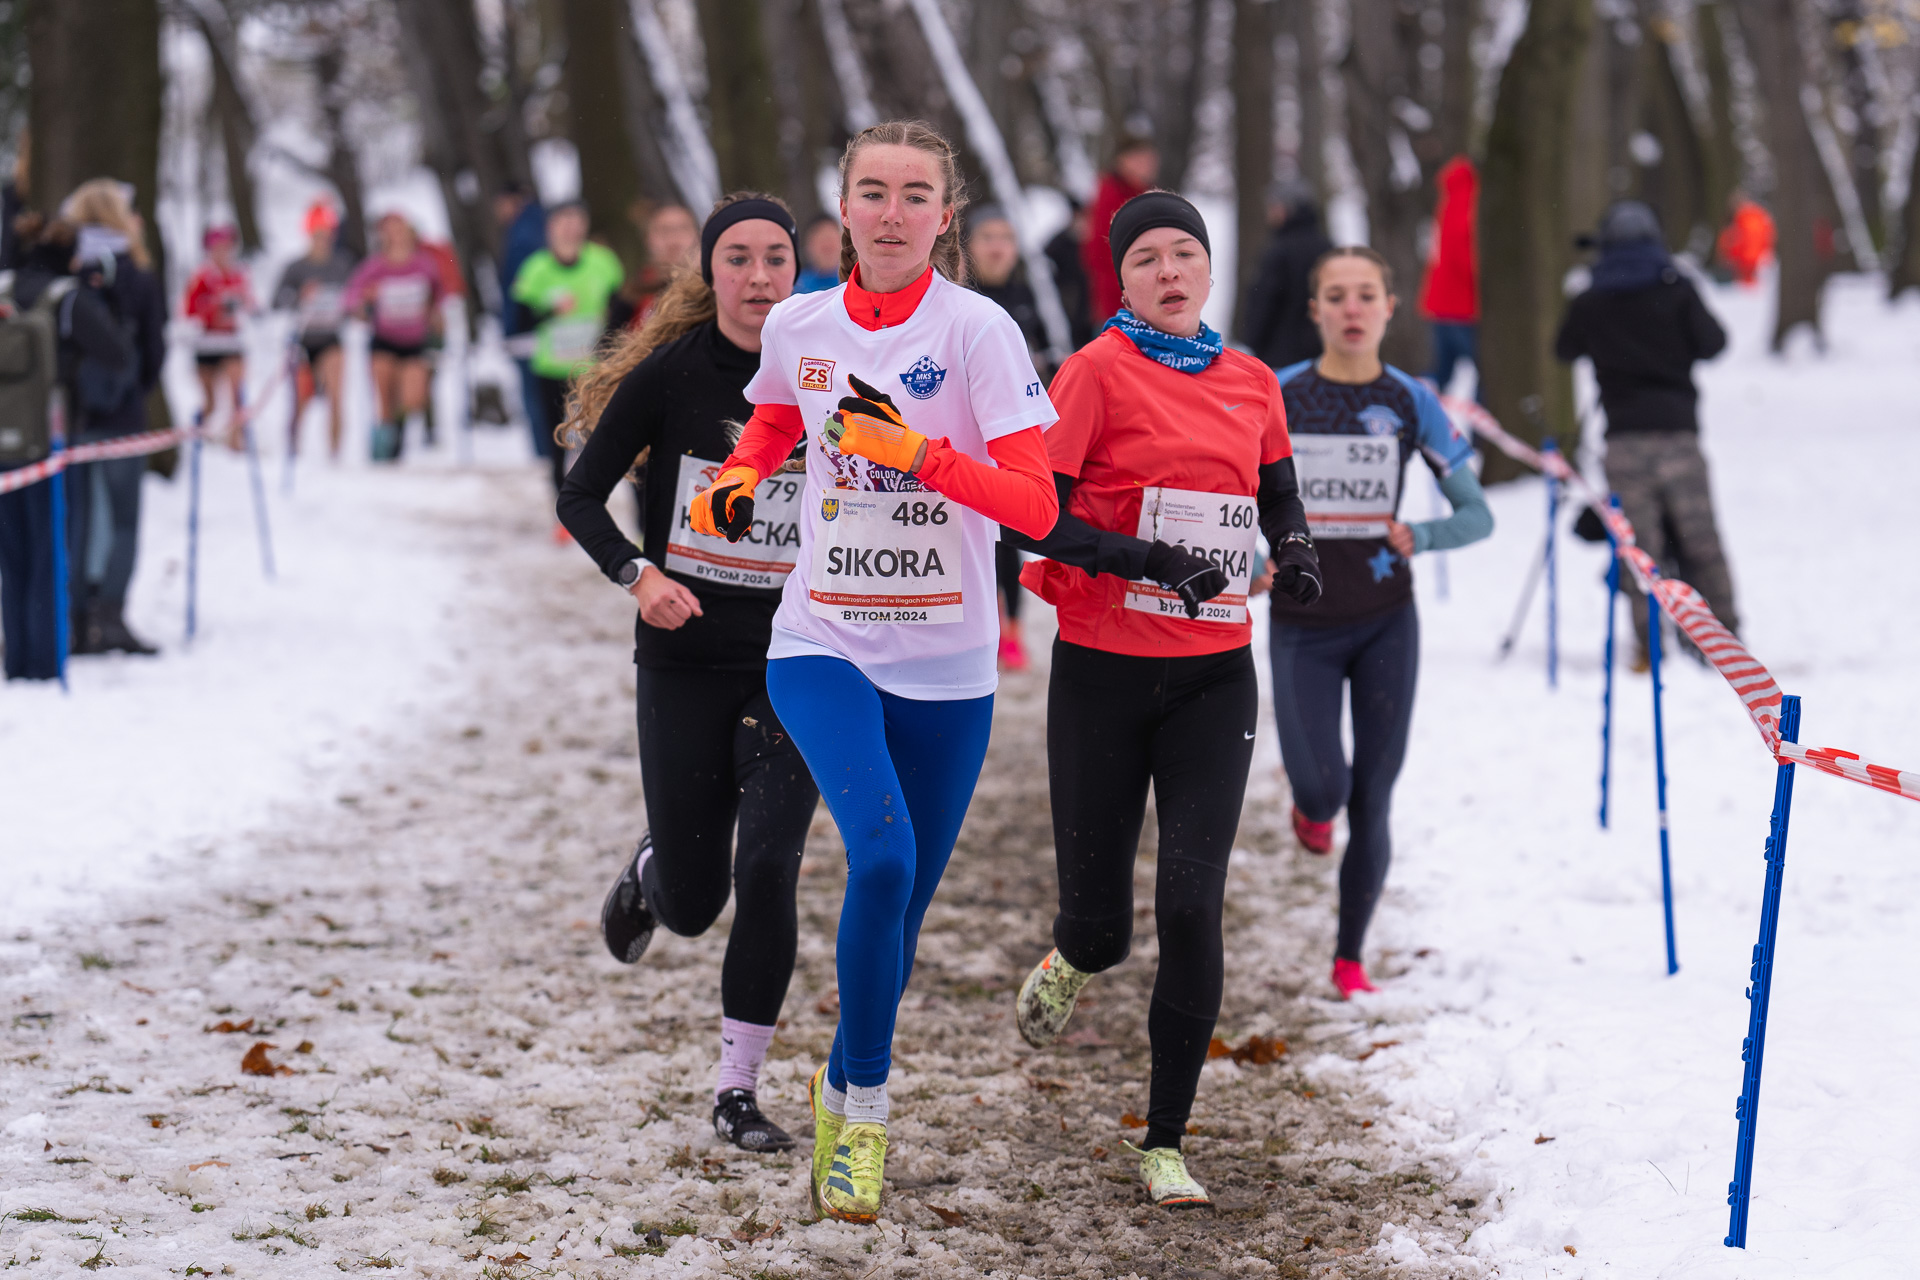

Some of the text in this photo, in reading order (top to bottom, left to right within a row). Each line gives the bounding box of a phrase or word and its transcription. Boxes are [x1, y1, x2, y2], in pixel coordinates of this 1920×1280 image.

[803, 367, 827, 383] ZS
[1026, 382, 1040, 397] 47
[1347, 443, 1389, 463] 529
[869, 470, 896, 479] COLOR
[766, 479, 798, 503] 79
[891, 501, 949, 526] 486
[1219, 503, 1253, 529] 160
[826, 546, 945, 578] SIKORA
[696, 565, 771, 585] BYTOM 2024
[837, 596, 871, 604] Mistrzostwa
[895, 597, 921, 606] Biegach
[843, 610, 928, 621] BYTOM 2024
[1206, 607, 1231, 618] 2024
